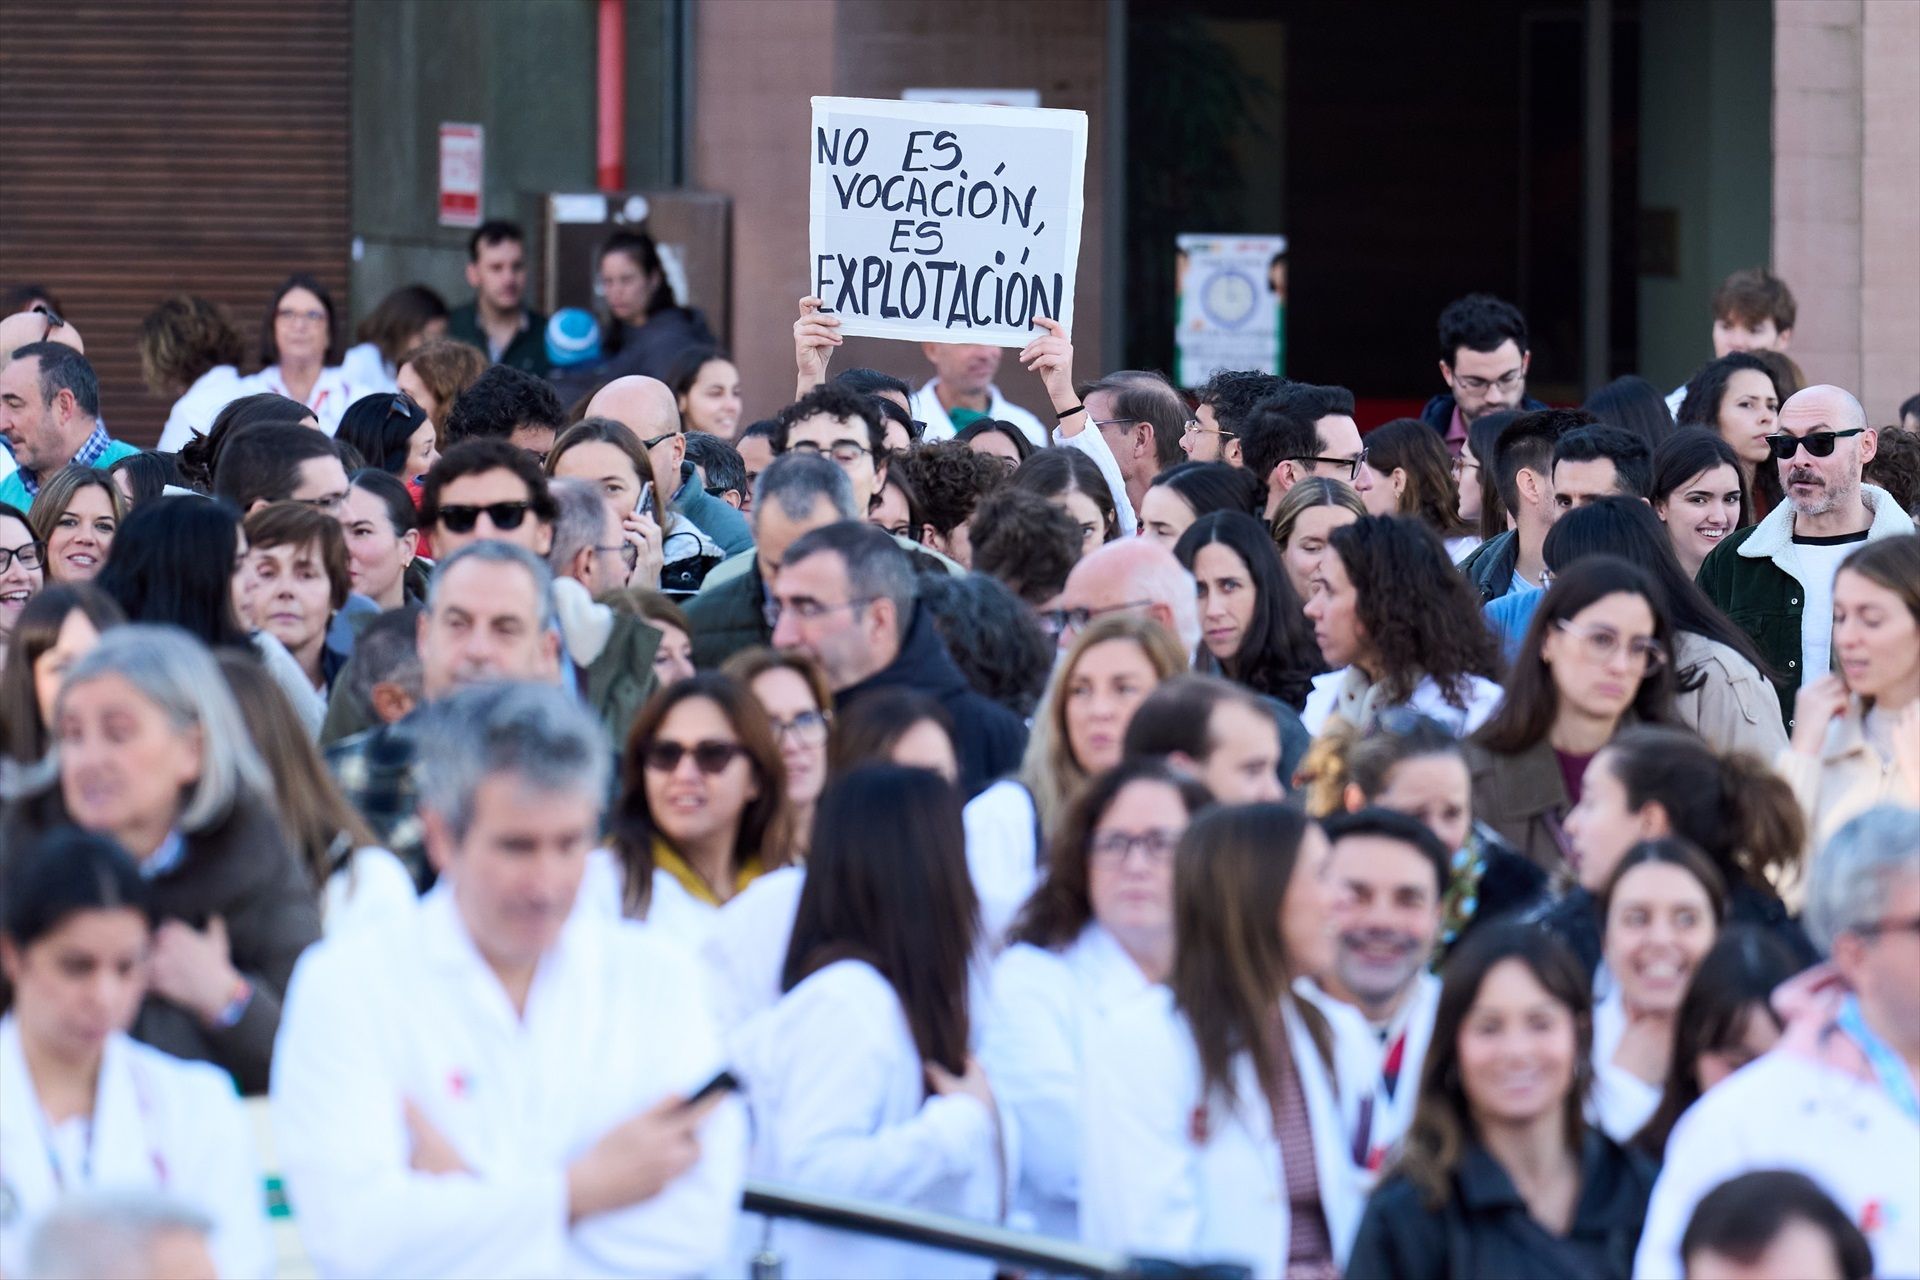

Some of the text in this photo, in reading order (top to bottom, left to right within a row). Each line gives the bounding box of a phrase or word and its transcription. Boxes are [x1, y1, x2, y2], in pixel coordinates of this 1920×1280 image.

[817, 126, 963, 171] NO ES
[889, 219, 944, 255] ES
